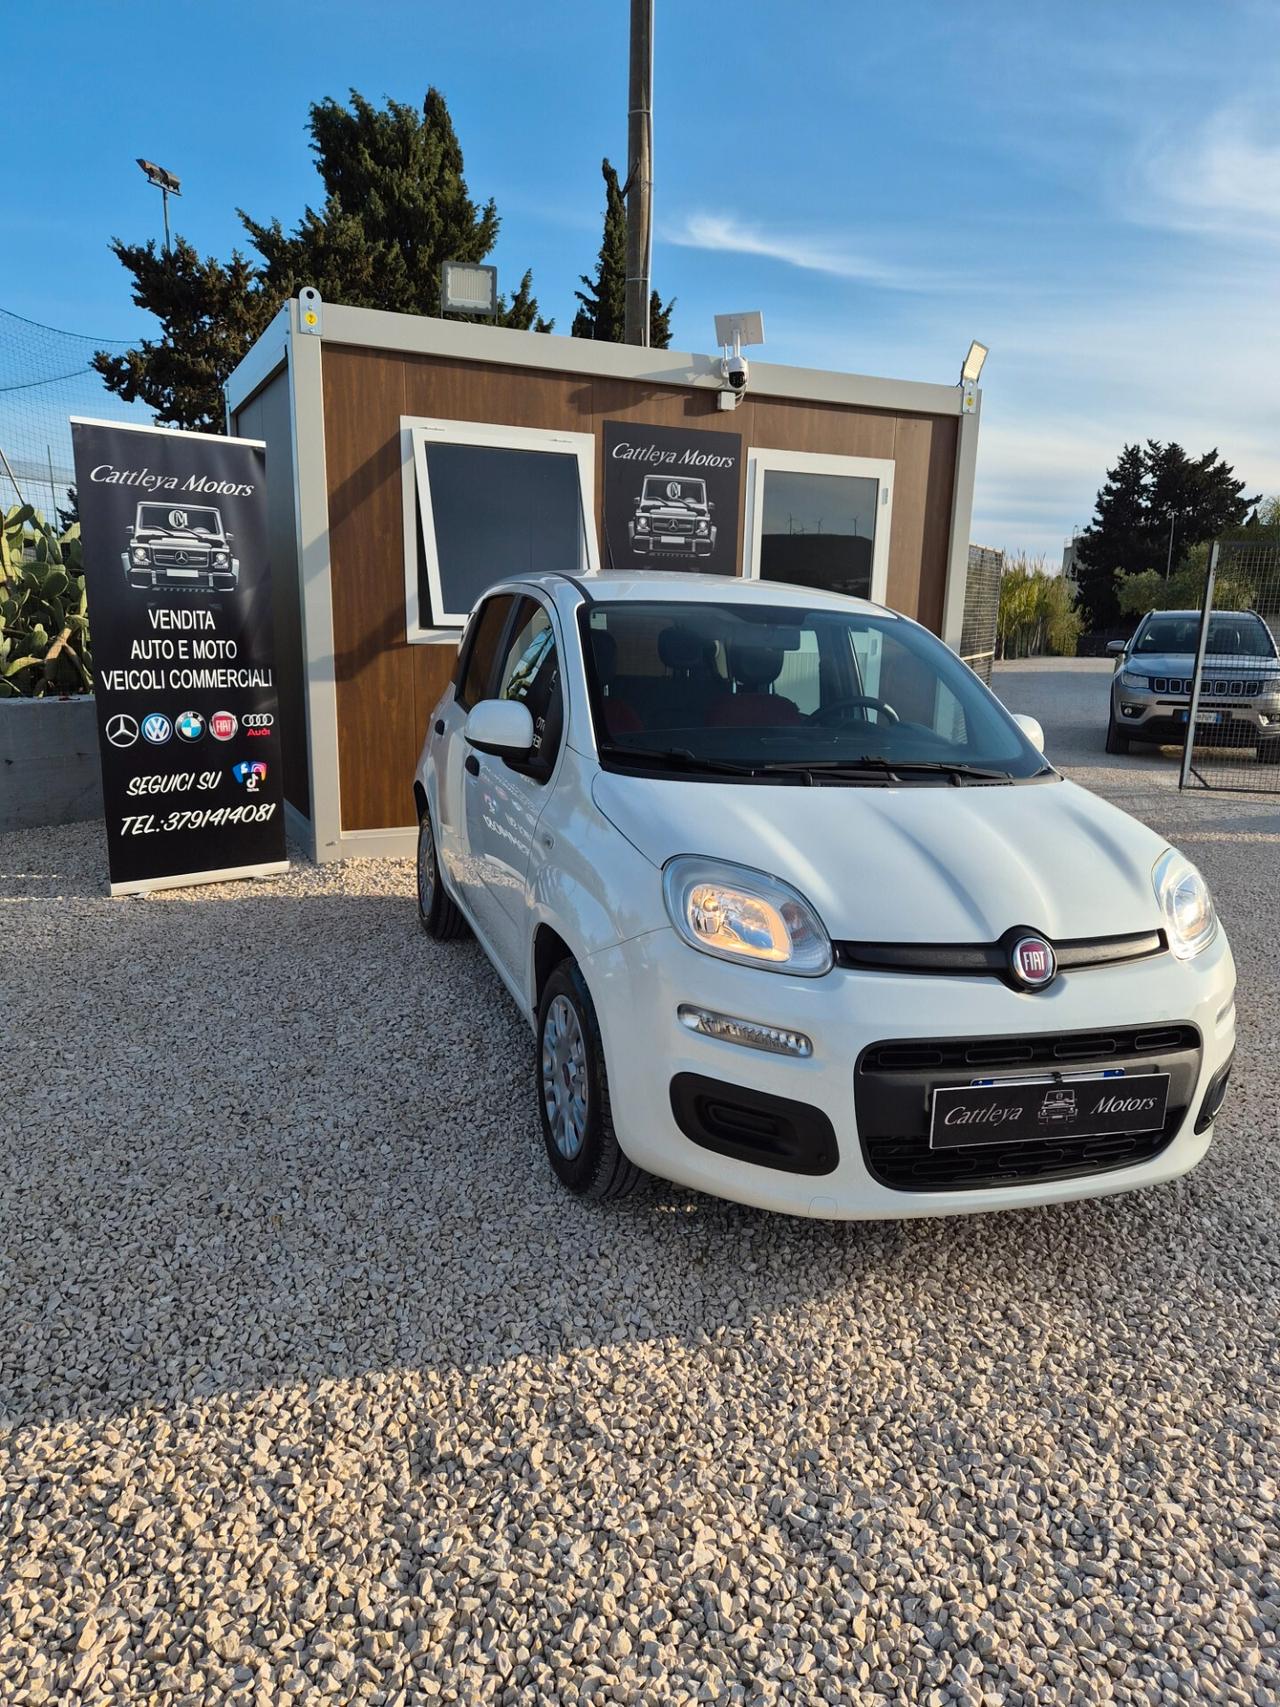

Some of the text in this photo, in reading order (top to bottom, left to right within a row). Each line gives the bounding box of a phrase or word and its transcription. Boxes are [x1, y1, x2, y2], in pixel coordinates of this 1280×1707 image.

[612, 442, 735, 468] Cattleya Motors
[90, 464, 255, 497] Cattleya Motors
[148, 609, 216, 630] VENDITA
[131, 639, 237, 660] AUTO E MOTO
[101, 669, 272, 690] VEICOLI COMMERCIALI
[215, 719, 232, 733] FIAT
[247, 727, 271, 737] Audi
[126, 771, 223, 796] SEGUICI SU
[1023, 950, 1045, 972] FIAT
[943, 1095, 1158, 1127] Cattleya Motors
